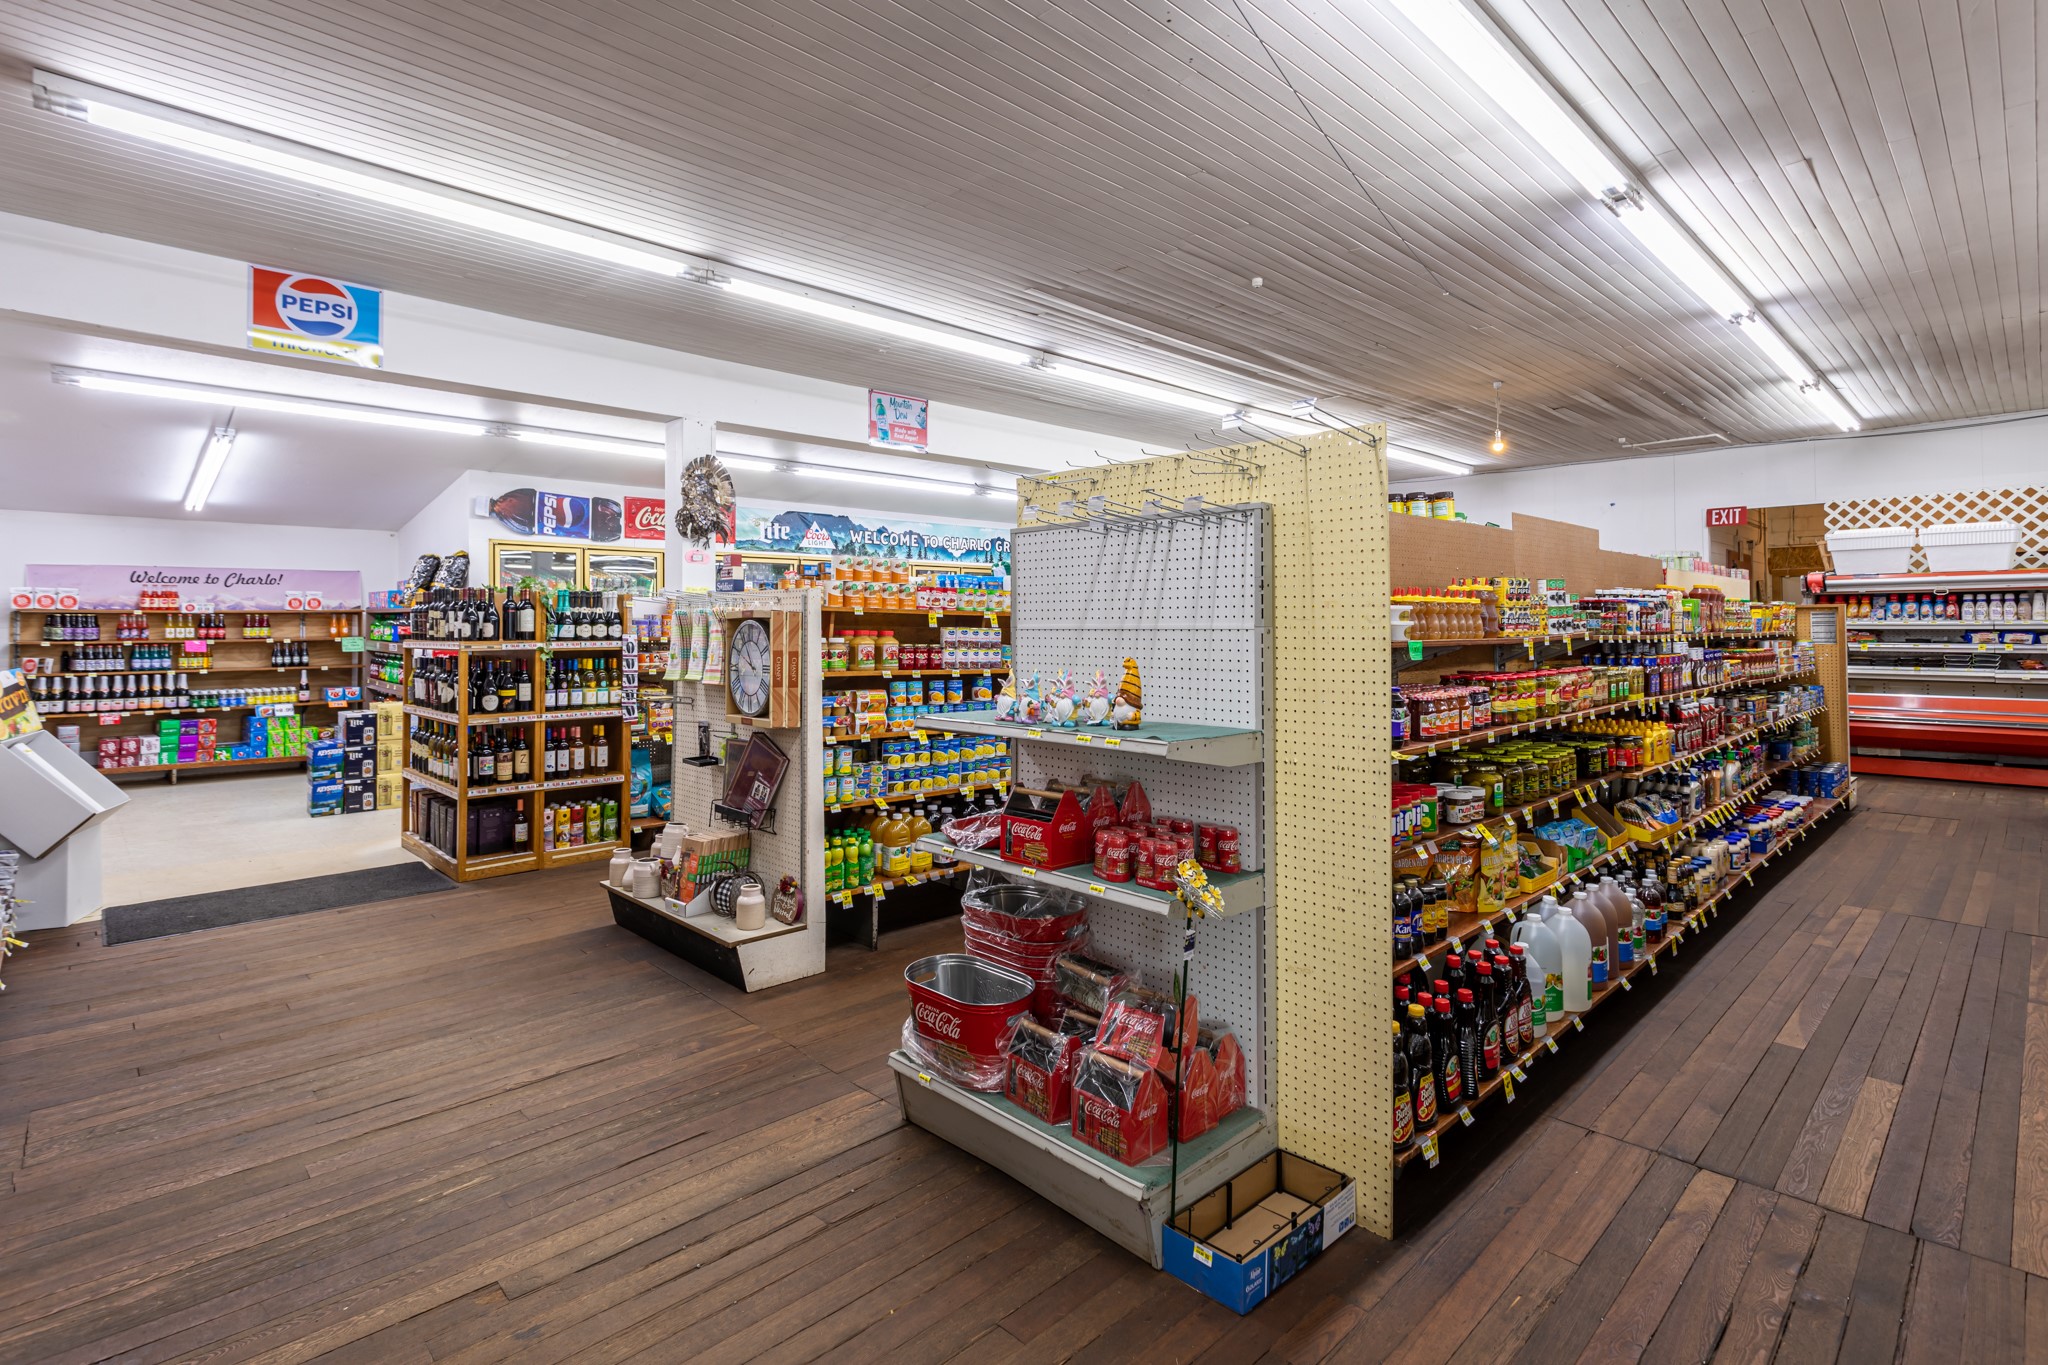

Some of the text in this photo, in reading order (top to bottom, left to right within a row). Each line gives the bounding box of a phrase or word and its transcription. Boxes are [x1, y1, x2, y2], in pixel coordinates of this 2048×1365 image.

[282, 294, 353, 320] PEPSI
[889, 397, 913, 410] Mountain
[893, 408, 908, 420] Dew
[543, 494, 557, 535] PEPSI
[1711, 508, 1742, 525] EXIT
[758, 522, 791, 541] Lite
[805, 529, 830, 540] Coors
[850, 529, 1011, 553] WELCOME TO CHARLO GR
[129, 570, 284, 588] Welcome to Charlo!
[350, 718, 364, 727] Lite
[349, 751, 363, 759] Lite
[348, 784, 362, 792] Lite
[1011, 822, 1044, 841] Coca-Cola
[1059, 822, 1077, 833] Coca-Cola
[1218, 840, 1239, 851] Coca-Co
[1107, 847, 1129, 860] Coca-Co
[1154, 854, 1178, 867] Coca-Col
[1433, 854, 1455, 864] ARDEN
[925, 1004, 941, 1014] DRINK
[915, 1002, 962, 1040] Coca-Cola
[1118, 1012, 1159, 1035] Coca-Cola
[1016, 1064, 1046, 1089] Coca-Cola
[1085, 1100, 1122, 1128] Coca-Cola
[1139, 1103, 1158, 1121] Coca-Cola
